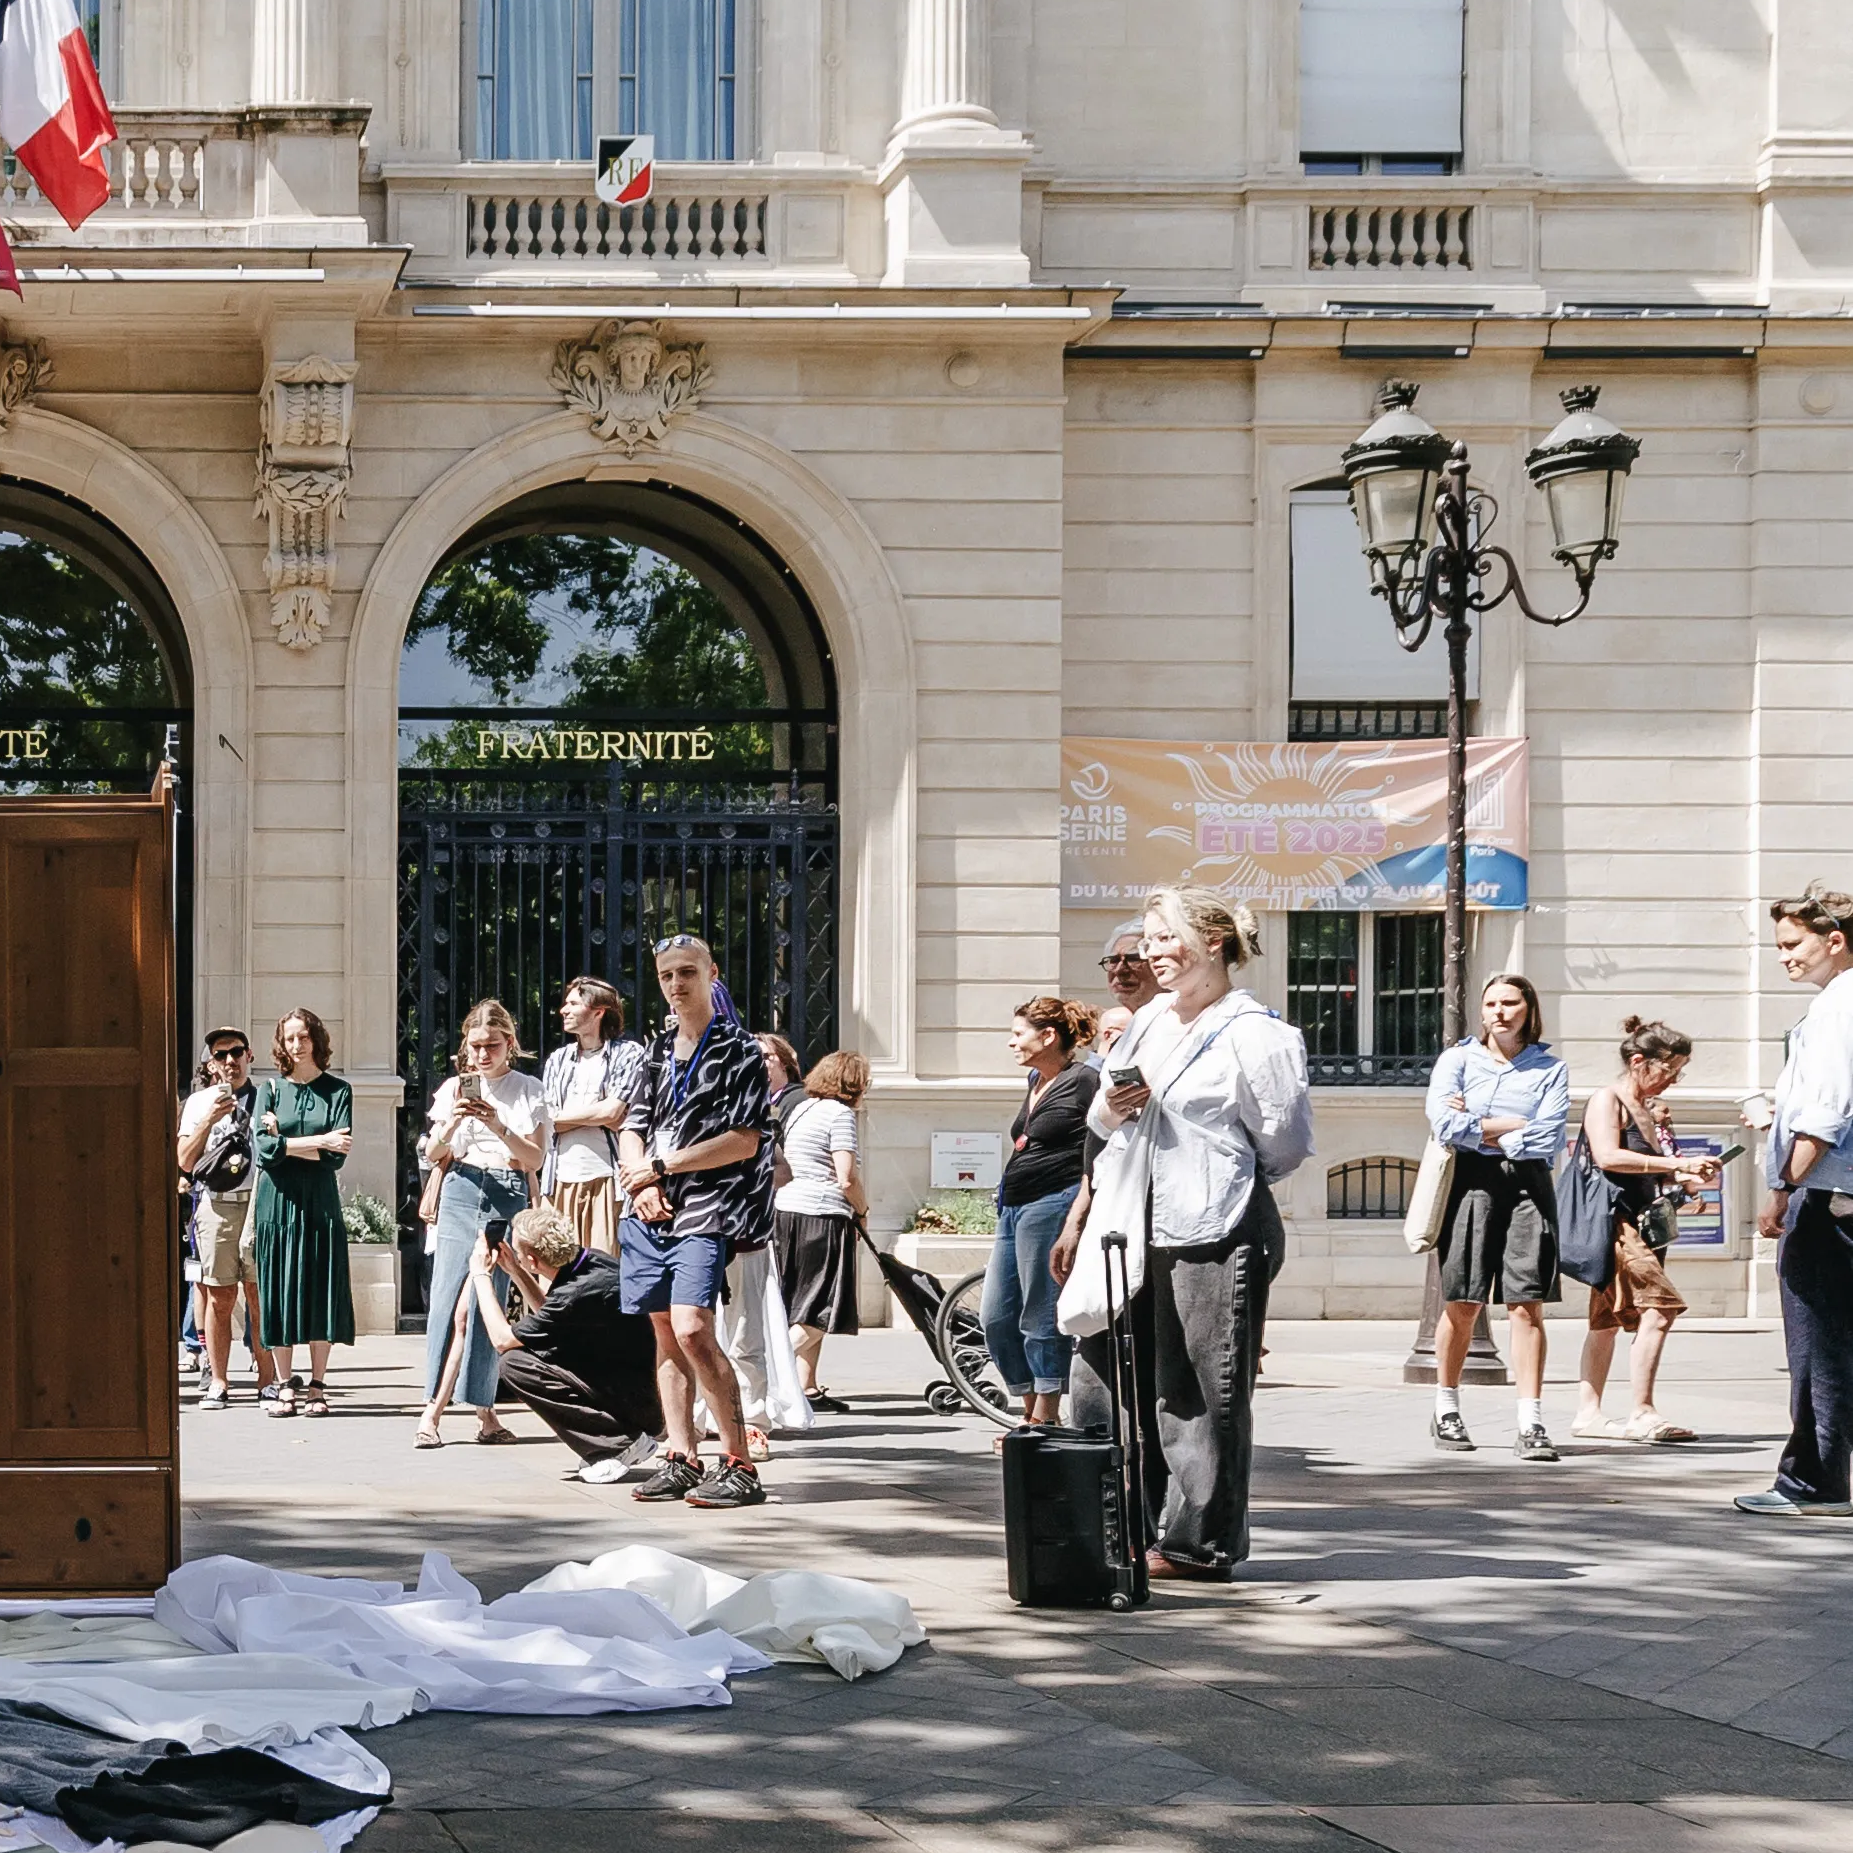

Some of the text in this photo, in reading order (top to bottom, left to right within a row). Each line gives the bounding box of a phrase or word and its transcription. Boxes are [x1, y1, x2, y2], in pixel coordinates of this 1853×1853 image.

[607, 157, 643, 188] RF
[476, 725, 715, 760] FRATERNITÉ
[1060, 804, 1127, 824] PARIS
[1194, 802, 1388, 818] PROGRAMMATION
[1200, 814, 1388, 855] ÉTÉ 2025
[1070, 884, 1097, 898] DU
[1100, 884, 1119, 898] 14
[1297, 885, 1337, 899] PUIS
[1341, 885, 1368, 899] DU
[1397, 885, 1422, 899] AU
[1465, 881, 1501, 899] OÛT
